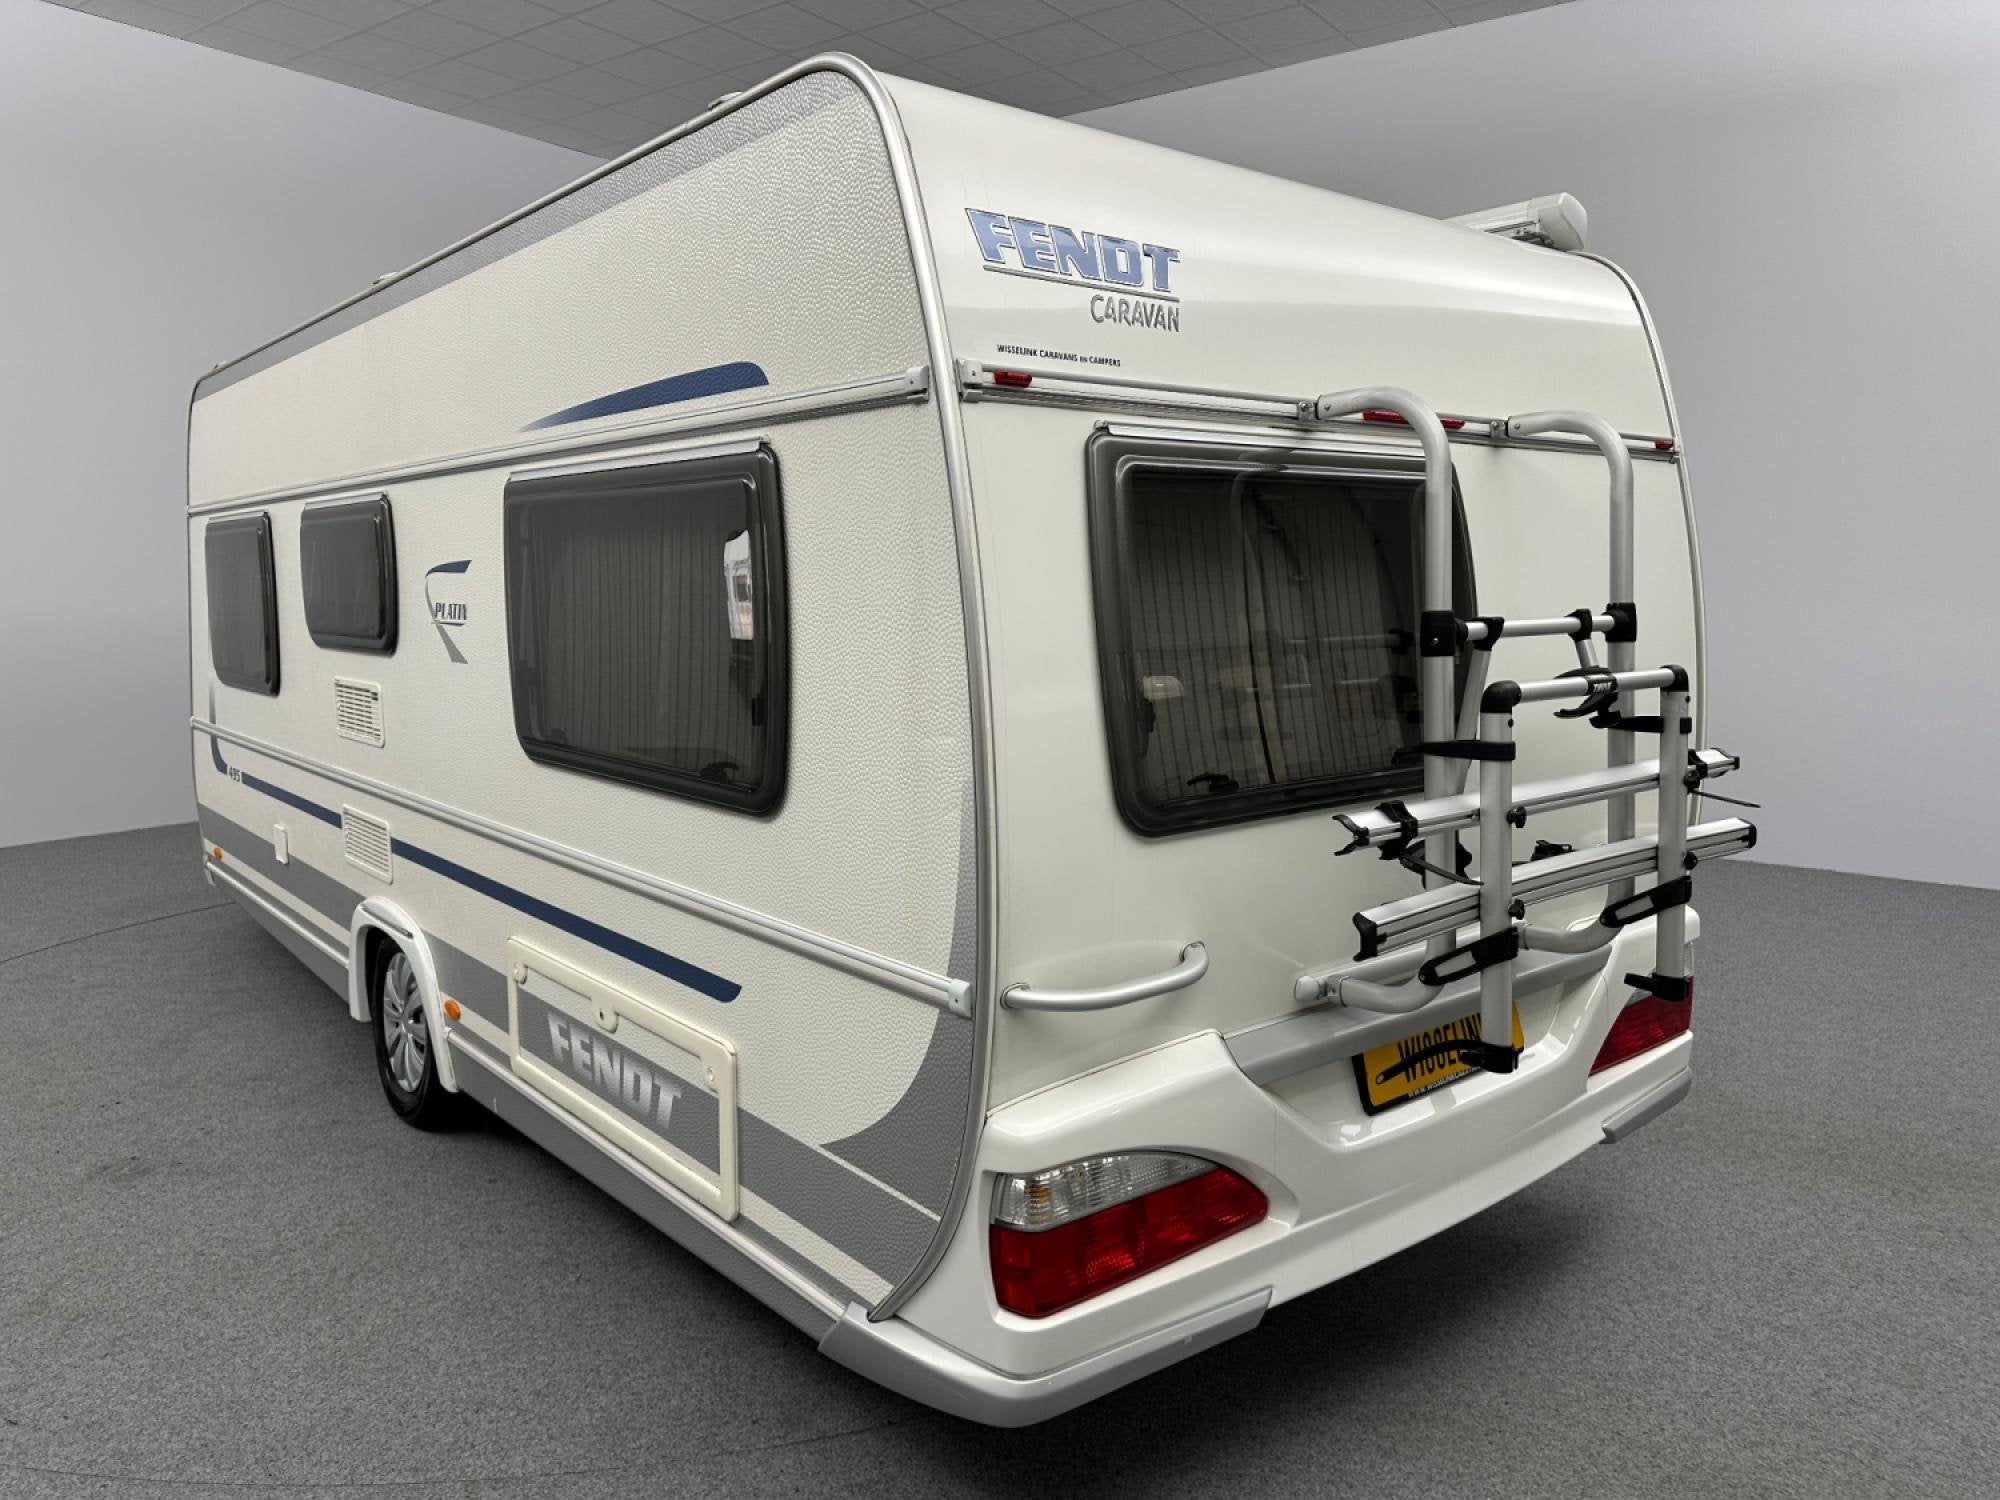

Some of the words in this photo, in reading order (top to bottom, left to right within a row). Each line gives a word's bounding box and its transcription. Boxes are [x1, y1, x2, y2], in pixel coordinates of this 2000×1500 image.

[964, 208, 1181, 292] FENDT
[1090, 295, 1180, 332] CARAVAN
[997, 344, 1037, 357] WISSELINK
[1040, 350, 1078, 362] CARAVANS
[1089, 356, 1121, 367] CAMPERS
[434, 602, 467, 620] PLATIN
[547, 1012, 682, 1129] FENDT
